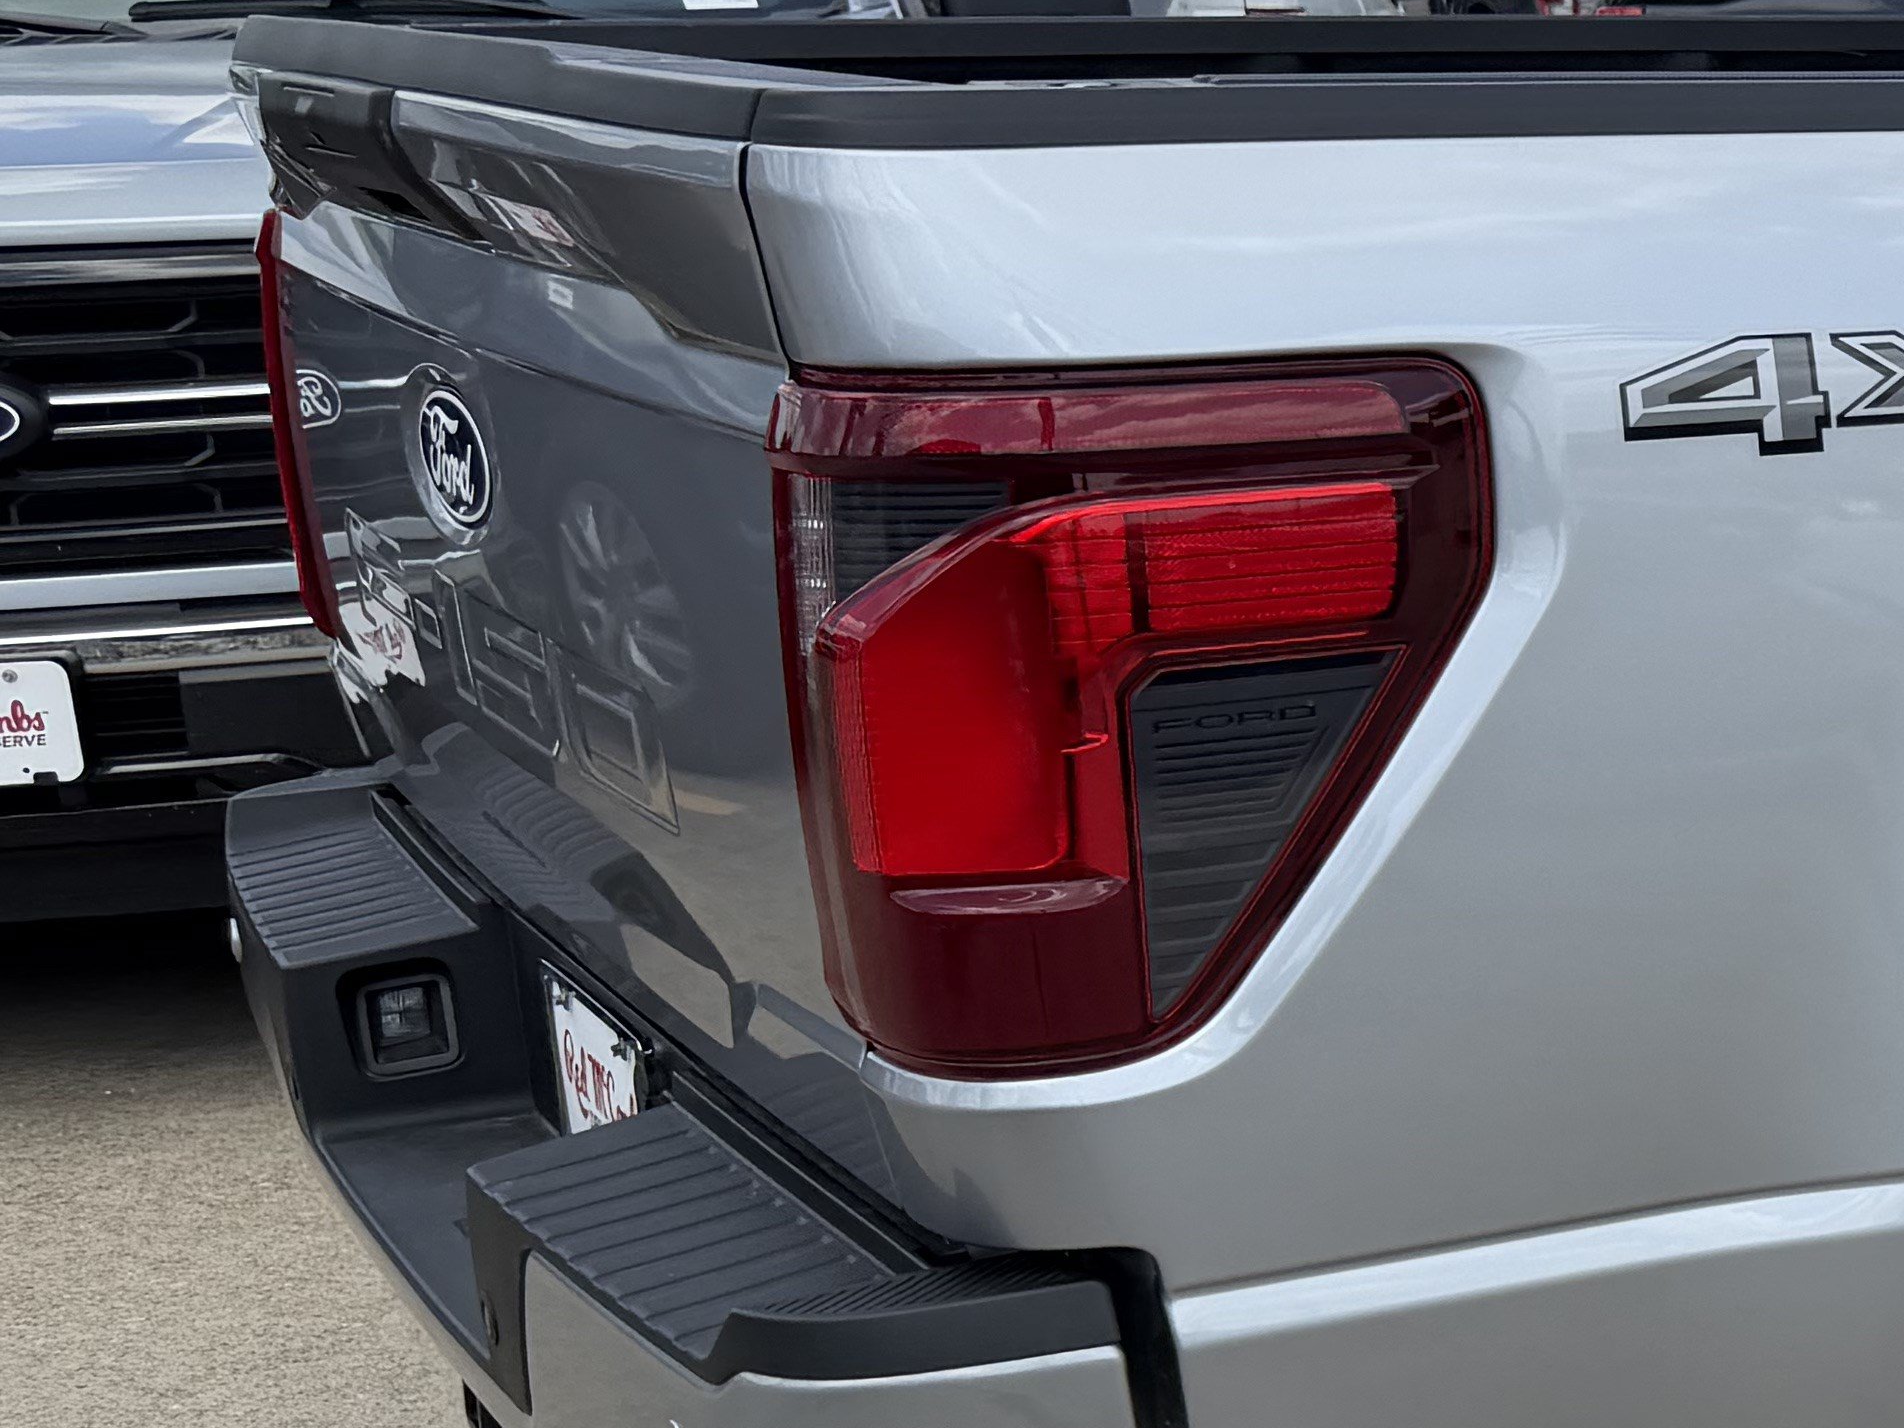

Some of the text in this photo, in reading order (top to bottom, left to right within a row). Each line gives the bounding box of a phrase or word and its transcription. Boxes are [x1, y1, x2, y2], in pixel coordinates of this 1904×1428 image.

[423, 403, 478, 515] Ford
[1152, 703, 1317, 735] FORD
[0, 733, 47, 748] ERVE
